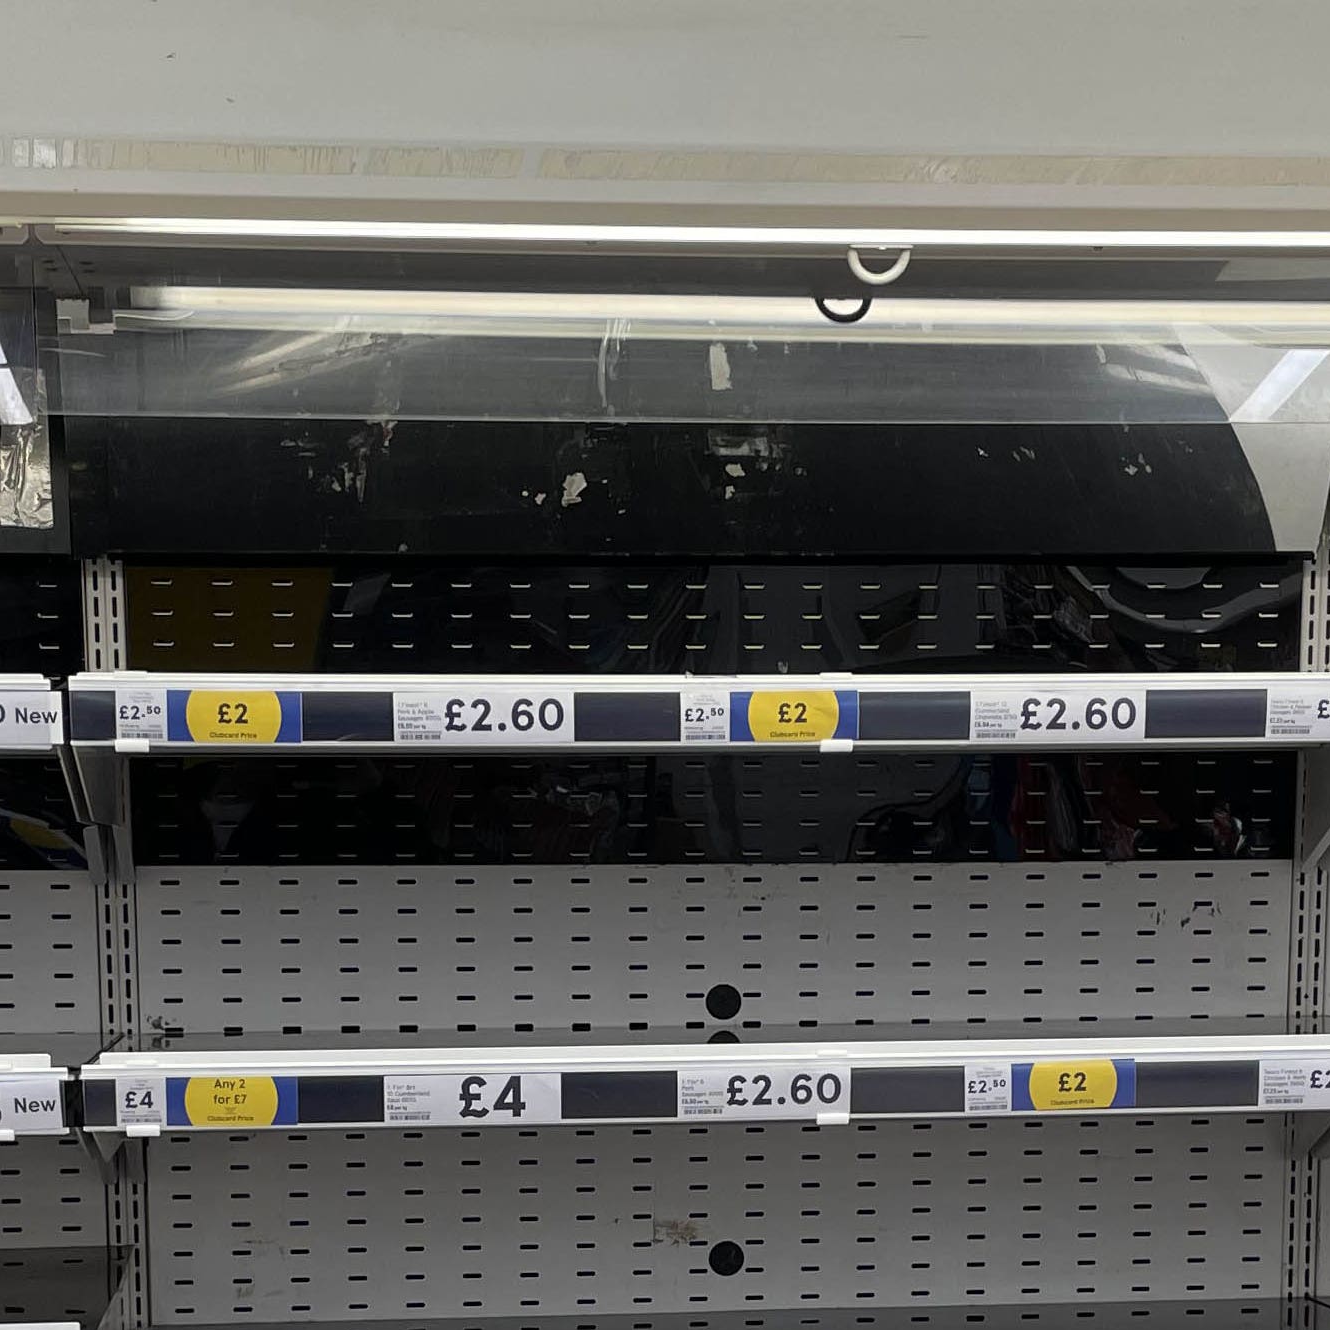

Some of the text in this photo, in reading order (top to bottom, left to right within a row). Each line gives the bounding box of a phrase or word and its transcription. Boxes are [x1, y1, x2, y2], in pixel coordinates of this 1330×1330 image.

[15, 708, 57, 723] New
[120, 706, 160, 720] £2.50
[218, 703, 248, 724] £2
[445, 699, 564, 731] £2.60
[685, 708, 724, 722] £2.50
[779, 703, 807, 723] £2
[1020, 698, 1136, 730] £2.60
[209, 732, 238, 740] Clubcard
[215, 1079, 246, 1090] Any 2
[727, 1074, 841, 1106] £2.60
[968, 1080, 1006, 1093] £2.50
[1059, 1072, 1086, 1092] £2
[125, 1091, 153, 1108] £4
[213, 1094, 247, 1105] for £7
[459, 1076, 525, 1118] £4
[15, 1098, 55, 1113] New
